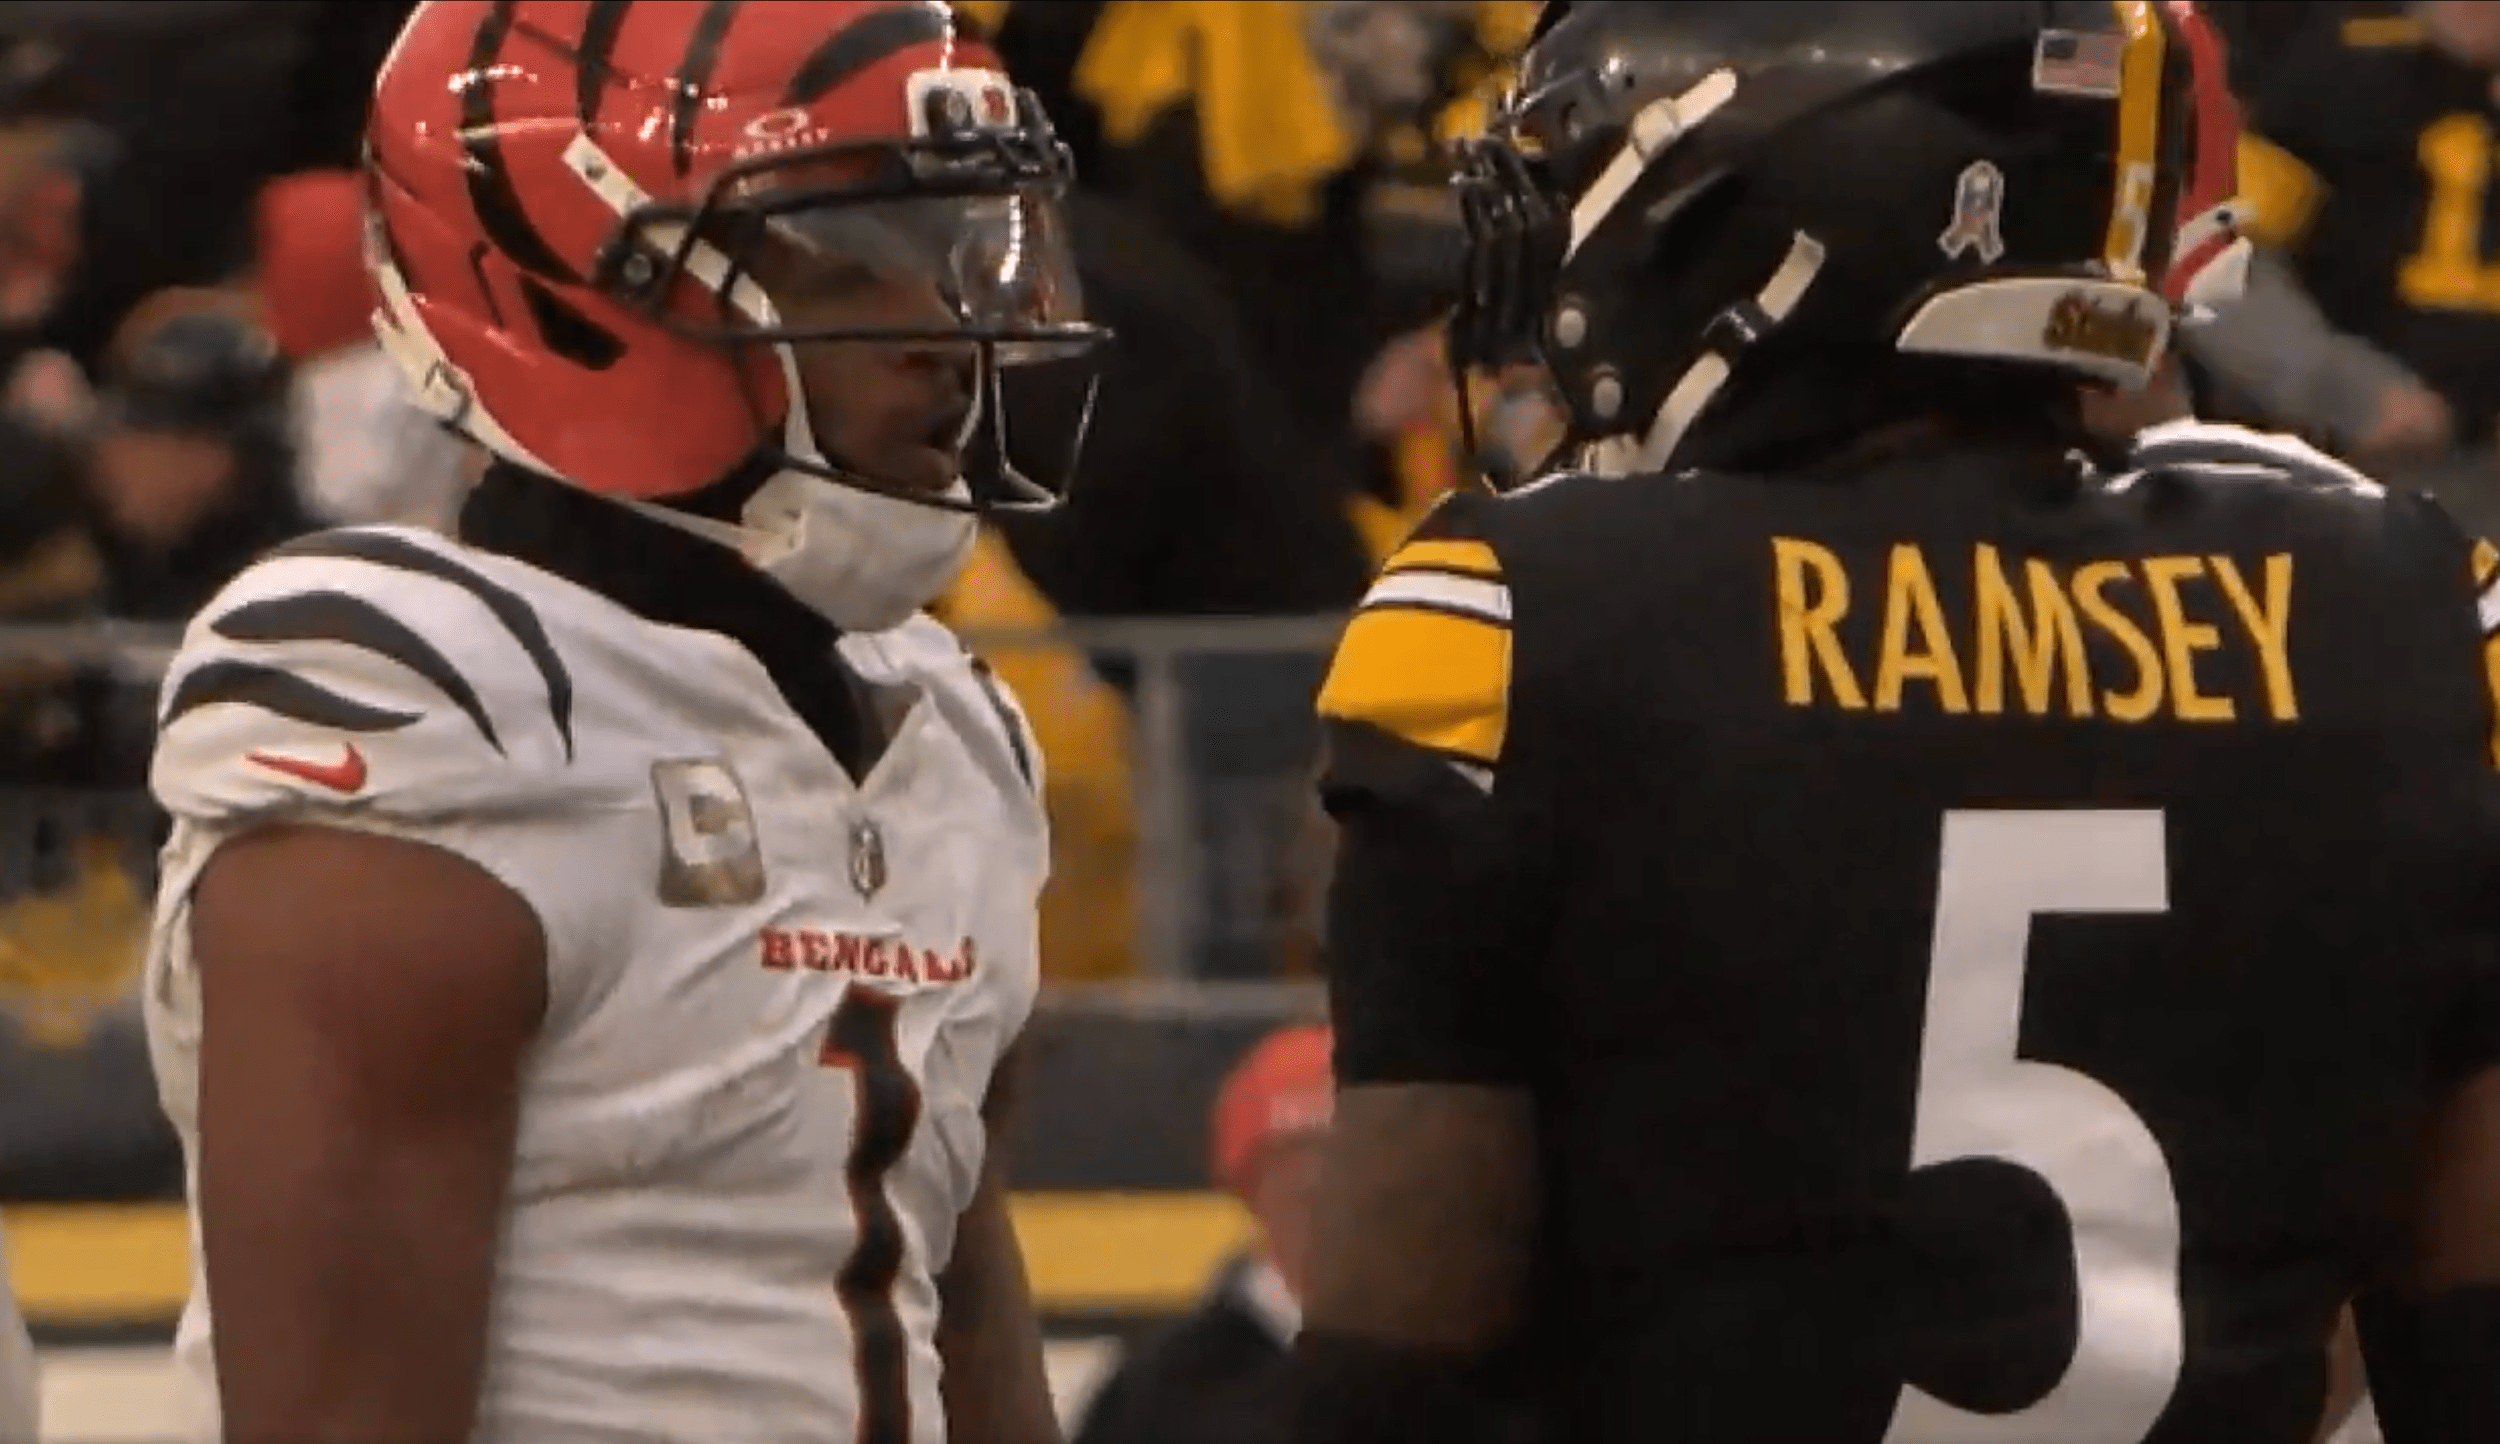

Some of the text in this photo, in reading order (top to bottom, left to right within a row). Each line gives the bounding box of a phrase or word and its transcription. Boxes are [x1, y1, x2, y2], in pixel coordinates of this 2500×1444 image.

[1772, 536, 2299, 722] RAMSEY
[818, 980, 923, 1444] 1
[1880, 808, 2185, 1444] 5
